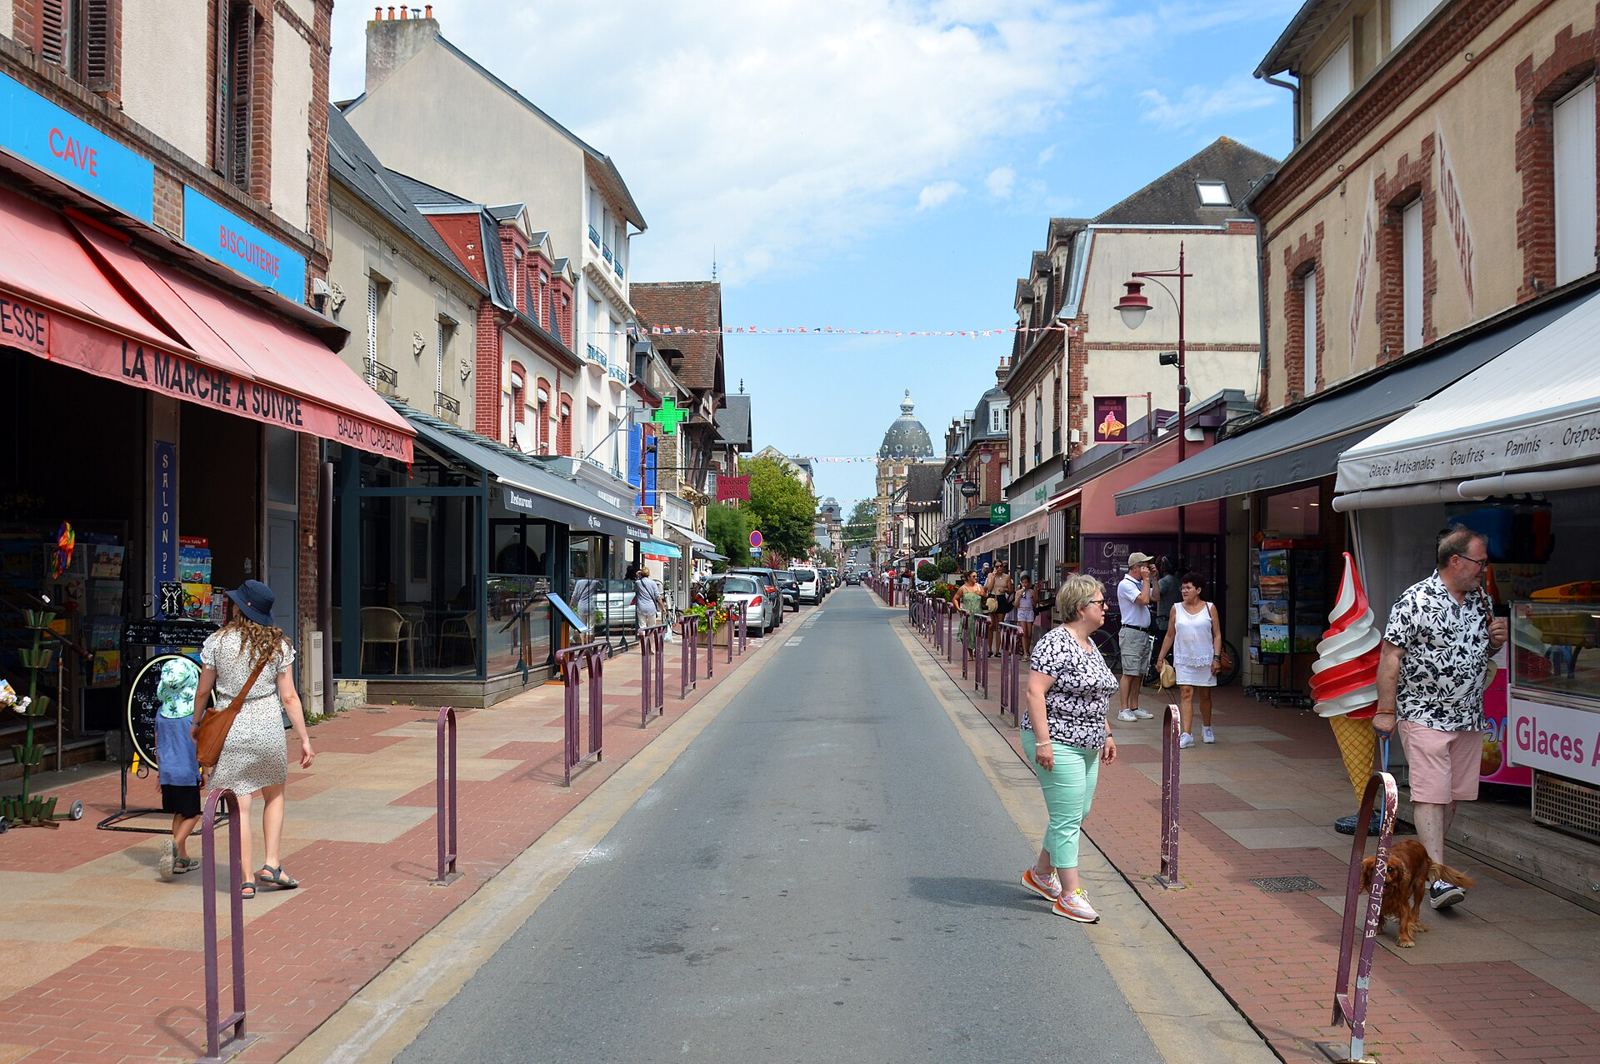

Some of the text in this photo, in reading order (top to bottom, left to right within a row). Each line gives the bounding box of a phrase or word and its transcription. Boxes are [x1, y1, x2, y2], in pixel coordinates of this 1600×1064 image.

[48, 127, 97, 177] CAVE
[1439, 133, 1473, 313] KODAK
[219, 224, 279, 278] BISCUITERIE
[121, 339, 303, 426] LA MARCHE A SUIVRE
[337, 415, 404, 455] BAZAR CADEAUX
[1369, 463, 1391, 478] Glaces
[1393, 456, 1436, 474] Artisanales
[1450, 449, 1485, 466] Gaufres
[1505, 437, 1541, 457] Paninis
[162, 552, 168, 574] DE
[1516, 716, 1584, 764] Glaces
